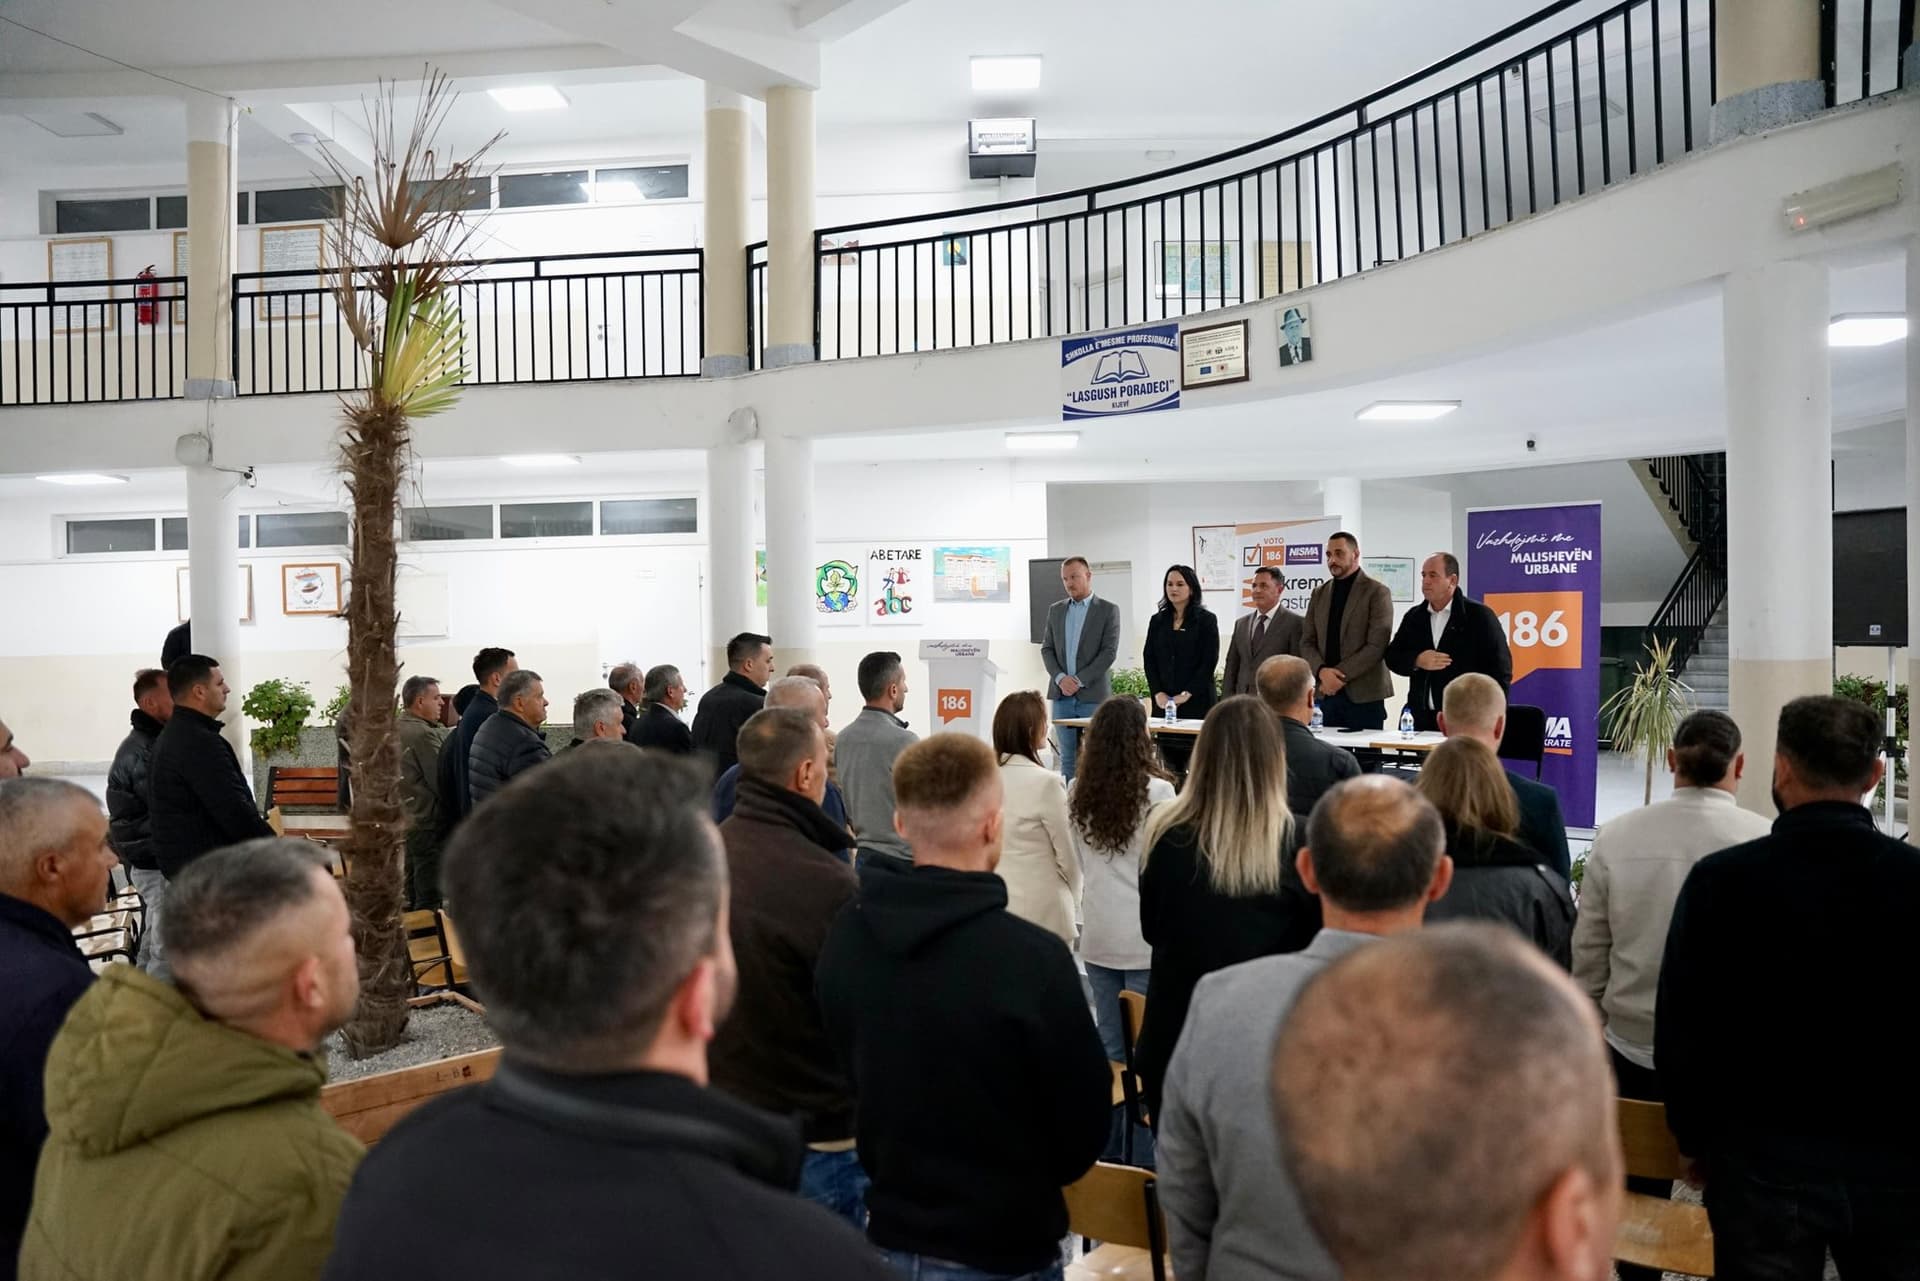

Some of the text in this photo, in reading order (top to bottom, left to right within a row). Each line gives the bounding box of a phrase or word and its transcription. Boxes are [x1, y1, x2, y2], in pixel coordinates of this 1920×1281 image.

[1065, 344, 1095, 361] SHKOLLA
[1101, 336, 1126, 348] MESME
[1127, 334, 1175, 347] PROFESIONALE
[1263, 536, 1284, 545] VOTO
[1551, 533, 1575, 542] me
[870, 549, 922, 561] ABETARE
[1266, 551, 1281, 561] 186
[1289, 546, 1319, 557] NISMA
[1510, 548, 1593, 563] MALISHEVËN
[1524, 563, 1578, 575] URBANE
[874, 588, 912, 616] abc
[1497, 610, 1568, 648] 186
[941, 695, 967, 710] 186
